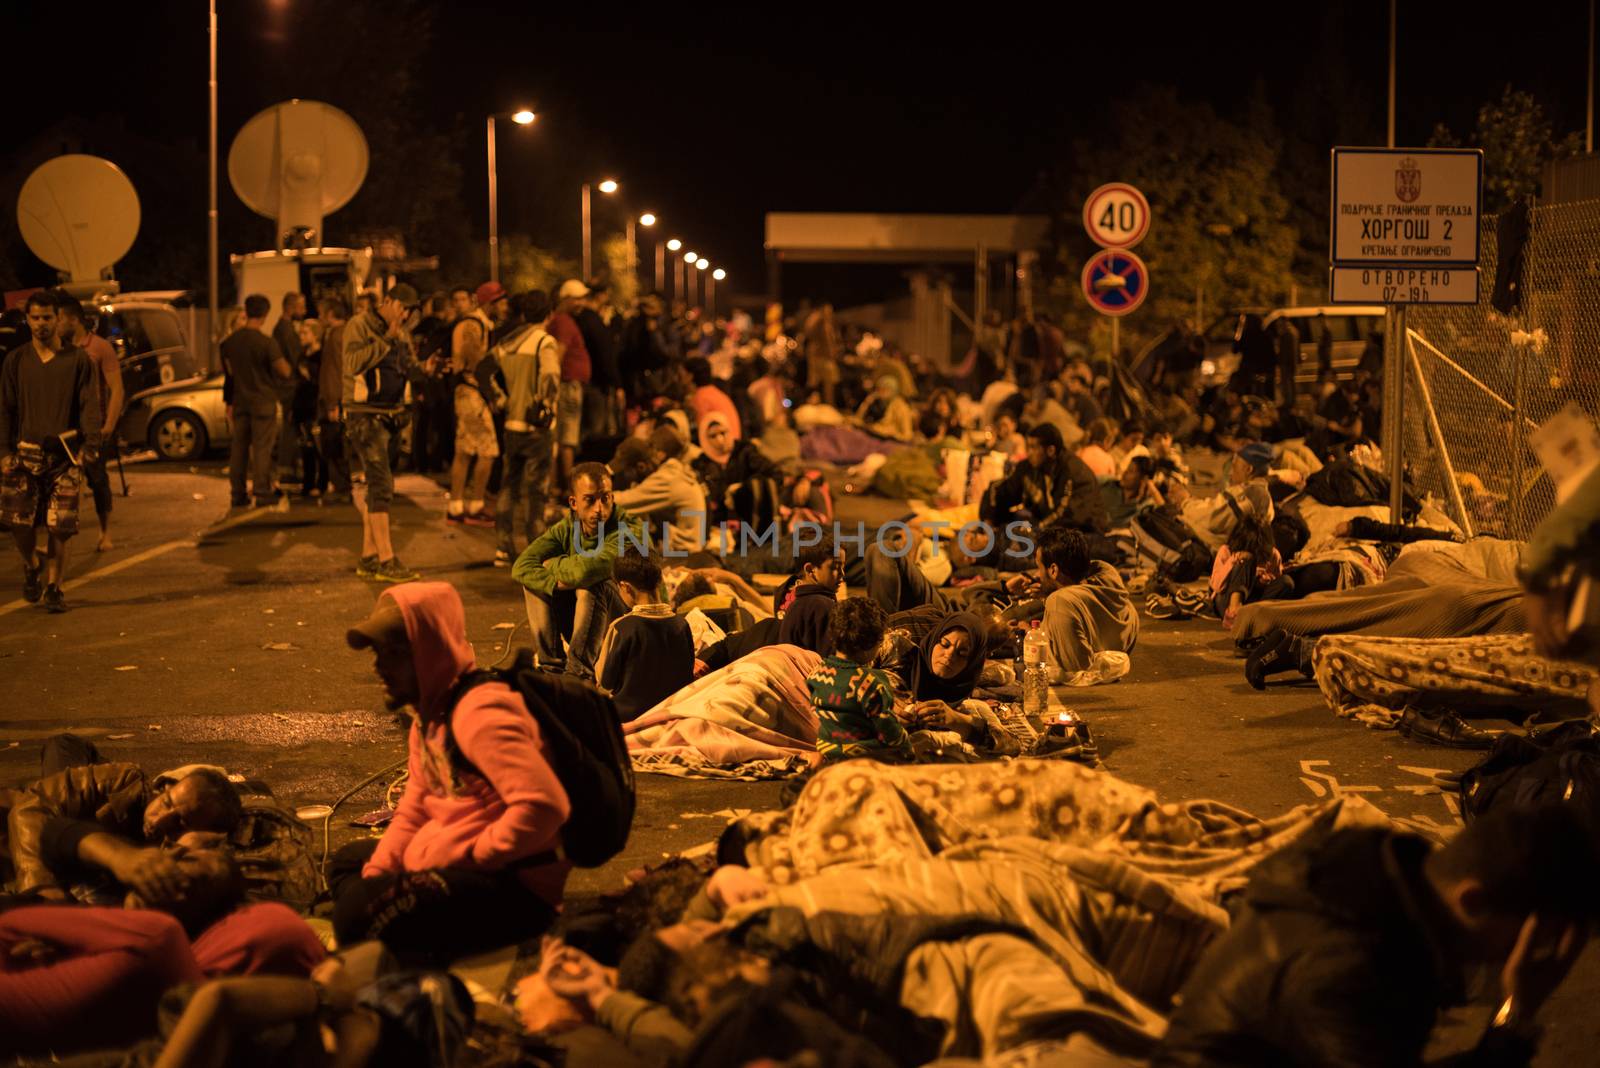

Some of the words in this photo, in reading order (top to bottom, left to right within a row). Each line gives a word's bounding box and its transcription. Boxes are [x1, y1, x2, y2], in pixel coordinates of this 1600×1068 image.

[1099, 201, 1135, 232] 40
[1341, 204, 1383, 216] ПОДРУЧЈЕ
[1387, 205, 1433, 216] ГРАНИЧНОГ
[1436, 205, 1472, 216] ПРЕЛАЗА
[1361, 218, 1430, 241] ХОРГОШ
[1443, 219, 1453, 241] 2
[1361, 245, 1397, 257] КРЕТАЊЕ
[1401, 245, 1451, 257] ОГРАНИЧЕНО
[1362, 270, 1450, 286] ОТВОРЕНО
